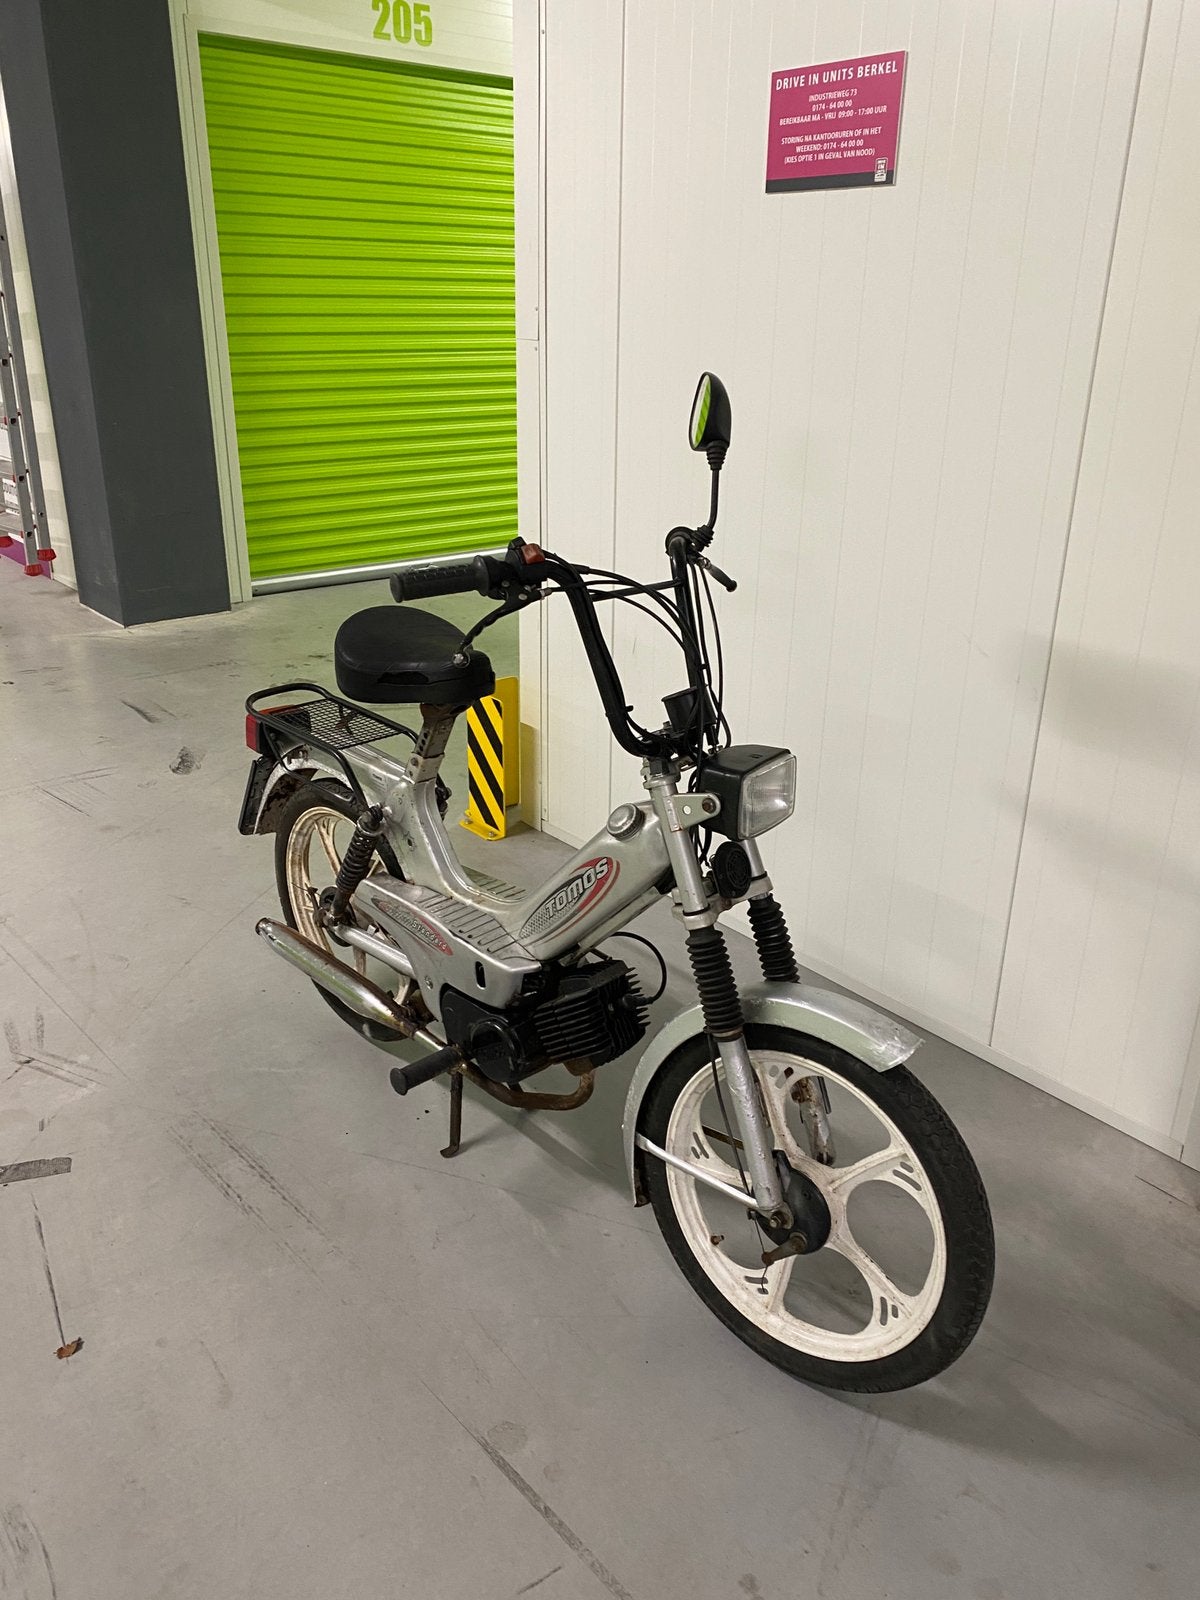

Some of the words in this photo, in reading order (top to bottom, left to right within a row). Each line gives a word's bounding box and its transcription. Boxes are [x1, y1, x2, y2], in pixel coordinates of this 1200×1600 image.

[372, 0, 432, 47] 205
[776, 75, 805, 90] DRIVE
[808, 73, 819, 85] IN
[823, 67, 854, 83] UNITS
[857, 60, 898, 78] BERKEL
[809, 90, 850, 102] INDUSTRIEWEG
[850, 88, 858, 97] 73
[812, 103, 826, 112] 0174
[829, 101, 837, 109] 64
[837, 100, 845, 108] 00
[845, 99, 853, 107] 00
[779, 114, 811, 126] BEREIKBAAR
[811, 113, 821, 121] MA
[838, 109, 854, 118] 09:00
[858, 107, 873, 115] 17:00
[874, 105, 887, 114] UUR
[781, 135, 804, 145] STORING
[804, 134, 812, 142] NA
[854, 129, 862, 137] OF
[862, 127, 870, 136] IN
[870, 126, 882, 135] HET
[795, 143, 822, 153] WEEKEND:
[822, 142, 837, 150] 0174
[840, 140, 848, 148] 64
[848, 139, 856, 147] 00
[856, 138, 864, 146] 00
[797, 153, 813, 162] OPTIE
[818, 152, 825, 160] IN
[825, 150, 842, 160] GEVAL
[843, 149, 855, 158] VAN
[856, 148, 876, 157] NOOD)
[545, 857, 609, 919] TOMOS
